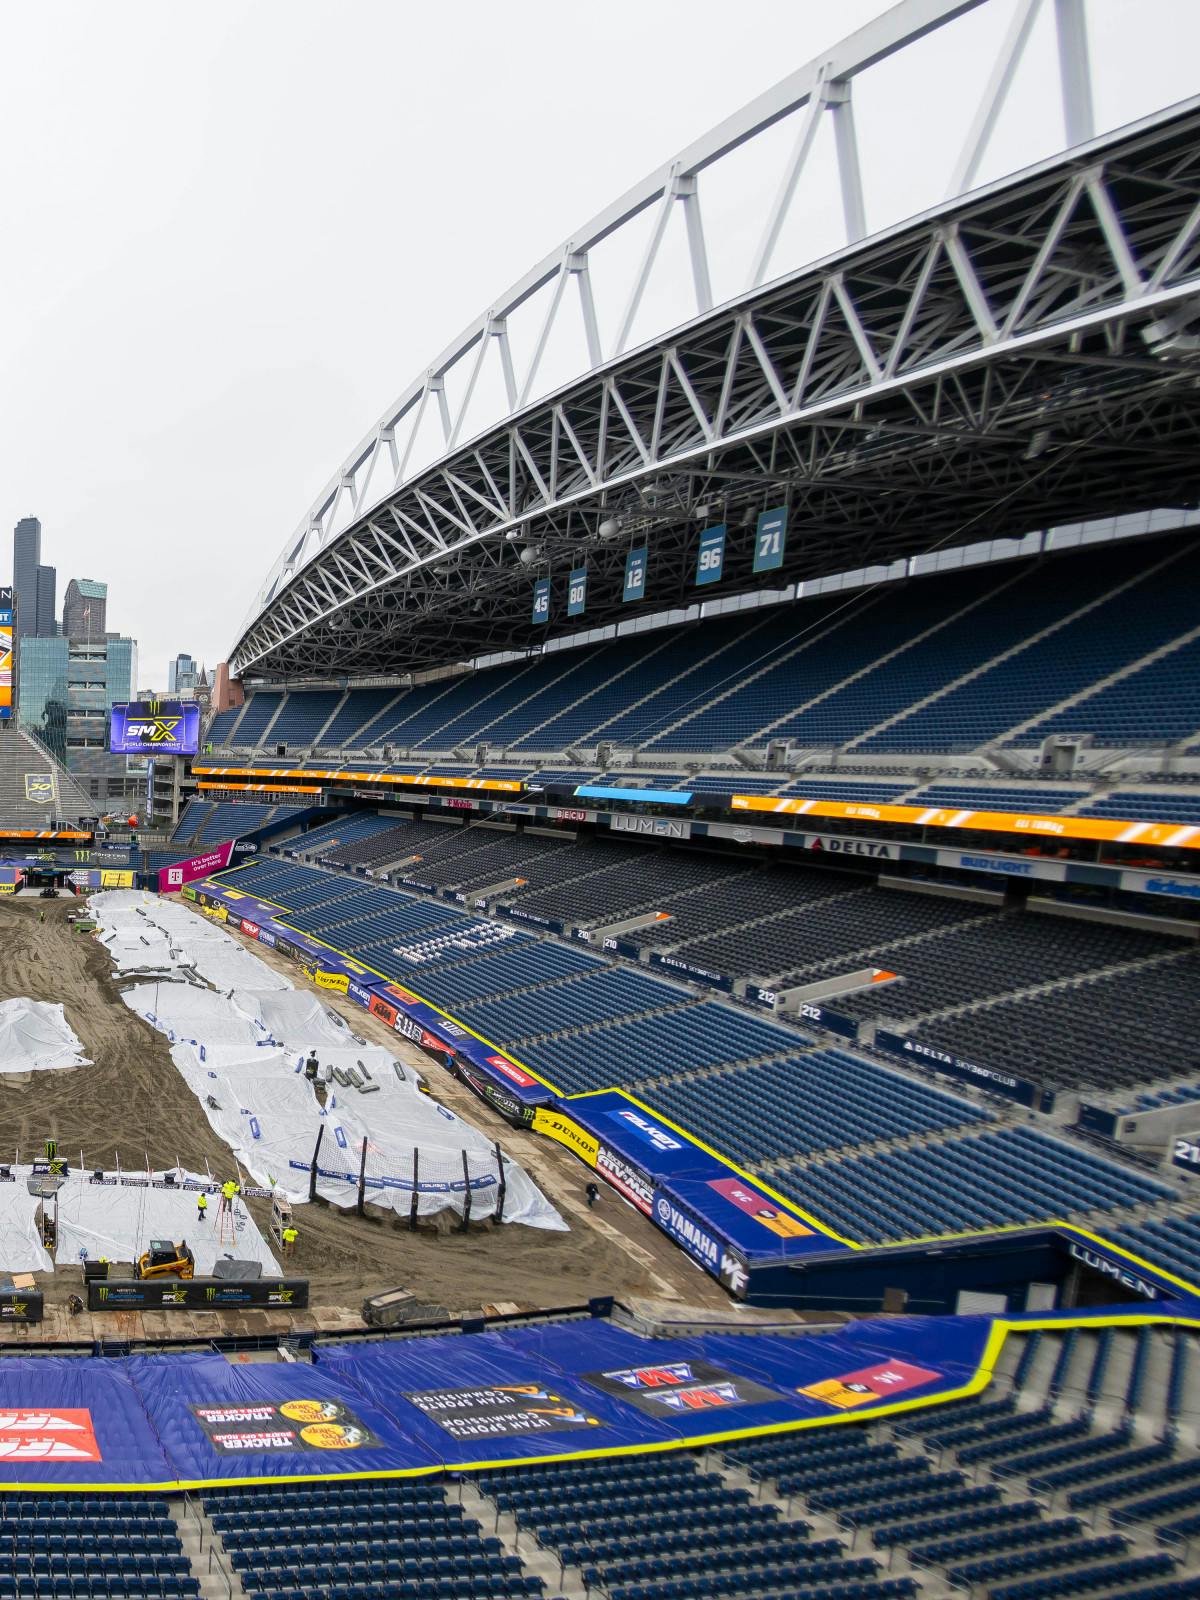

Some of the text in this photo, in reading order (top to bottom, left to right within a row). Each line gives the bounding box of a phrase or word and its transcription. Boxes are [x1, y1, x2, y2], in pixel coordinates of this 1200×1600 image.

[759, 531, 781, 557] 71
[699, 547, 722, 571] 96
[626, 568, 643, 589] 12
[570, 585, 584, 604] 80
[534, 595, 548, 613] 45
[126, 721, 178, 741] SMX
[557, 810, 585, 821] BECU
[616, 815, 684, 838] LUMEN
[829, 838, 890, 858] DELTA
[191, 853, 221, 867] It's better
[193, 863, 206, 872] over
[960, 855, 1033, 875] BUD LIGHT
[514, 910, 528, 918] DELTA
[578, 929, 589, 939] 210
[605, 938, 617, 949] 210
[666, 957, 688, 970] DELTA
[318, 975, 348, 988] DUNLOP
[349, 983, 370, 1002] FALKEN
[758, 988, 775, 1003] 212
[374, 1002, 392, 1021] KTM
[801, 1004, 822, 1021] 212
[394, 1012, 412, 1039] 5.11
[915, 1043, 951, 1064] DELTA
[550, 1120, 596, 1154] DUNLOP
[618, 1110, 683, 1150] FALKEN
[34, 1163, 63, 1175] SMX
[607, 1151, 625, 1168] ROCKY
[625, 1164, 655, 1195] MOUNTAIN
[670, 1207, 718, 1264] YAMAHA
[1068, 1243, 1156, 1300] LUMEN
[162, 1292, 187, 1302] SMX
[269, 1292, 295, 1302] SMX
[1, 1303, 28, 1314] SMX
[412, 1389, 505, 1404] COMMISSION
[419, 1395, 516, 1412] UTAH SPORTS
[284, 1402, 315, 1411] Shops
[299, 1407, 314, 1416] Pro
[207, 1412, 272, 1423] TRACKER
[301, 1412, 325, 1421] Bass
[441, 1411, 540, 1428] COMMISSION
[304, 1427, 337, 1436] Shops
[450, 1418, 552, 1436] UTAH SPORTS
[223, 1437, 293, 1449] TRACKER
[320, 1437, 348, 1447] Bass
[321, 1432, 337, 1440] Pro
